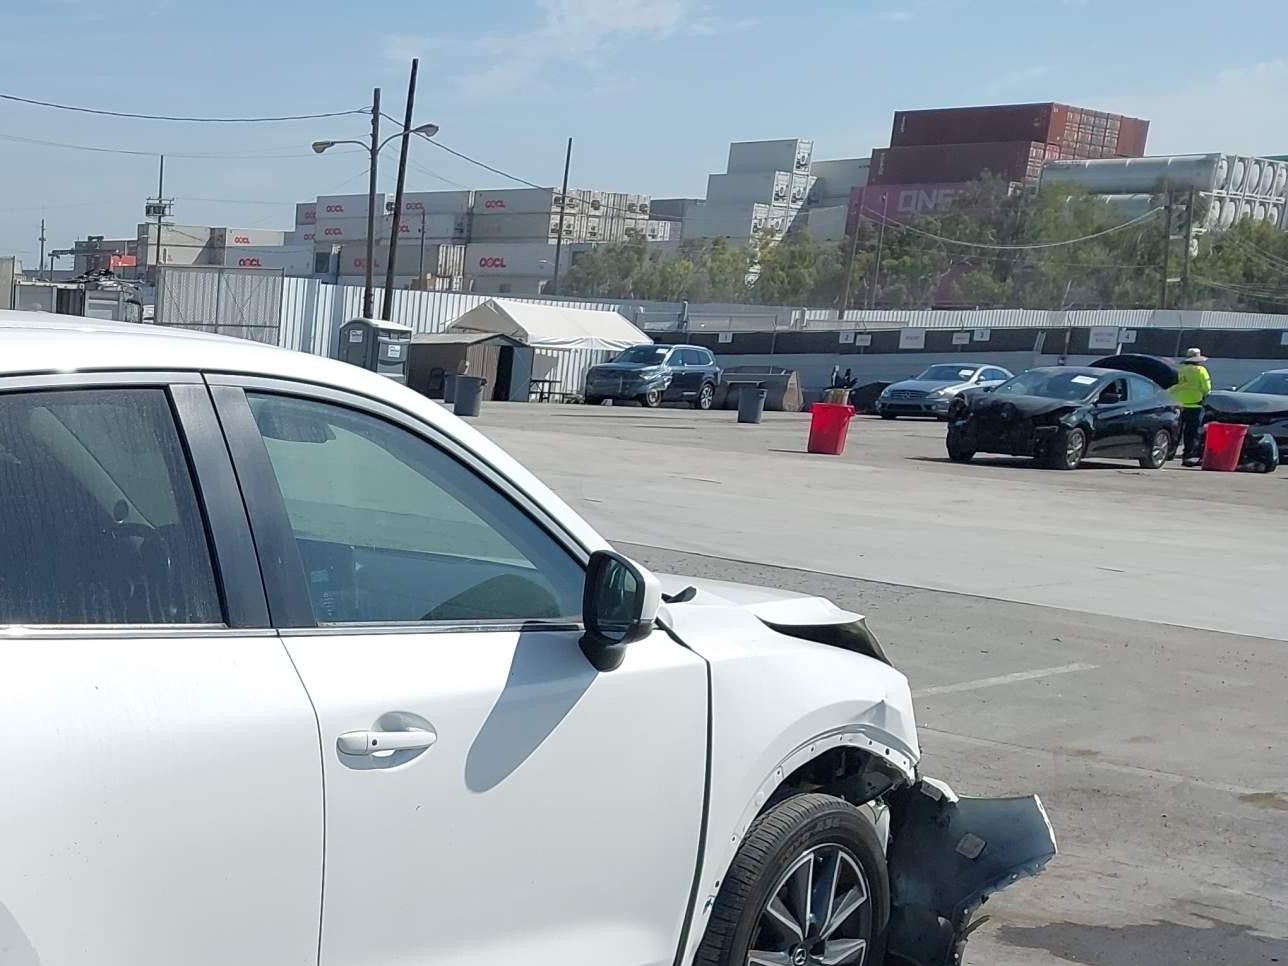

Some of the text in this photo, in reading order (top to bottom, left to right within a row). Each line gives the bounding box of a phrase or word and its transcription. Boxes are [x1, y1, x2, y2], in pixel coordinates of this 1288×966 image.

[326, 205, 344, 213] OOCL
[324, 228, 343, 236] OOCL
[234, 236, 250, 244] OOCL
[239, 258, 262, 267] OOCL
[480, 257, 506, 268] OOCL
